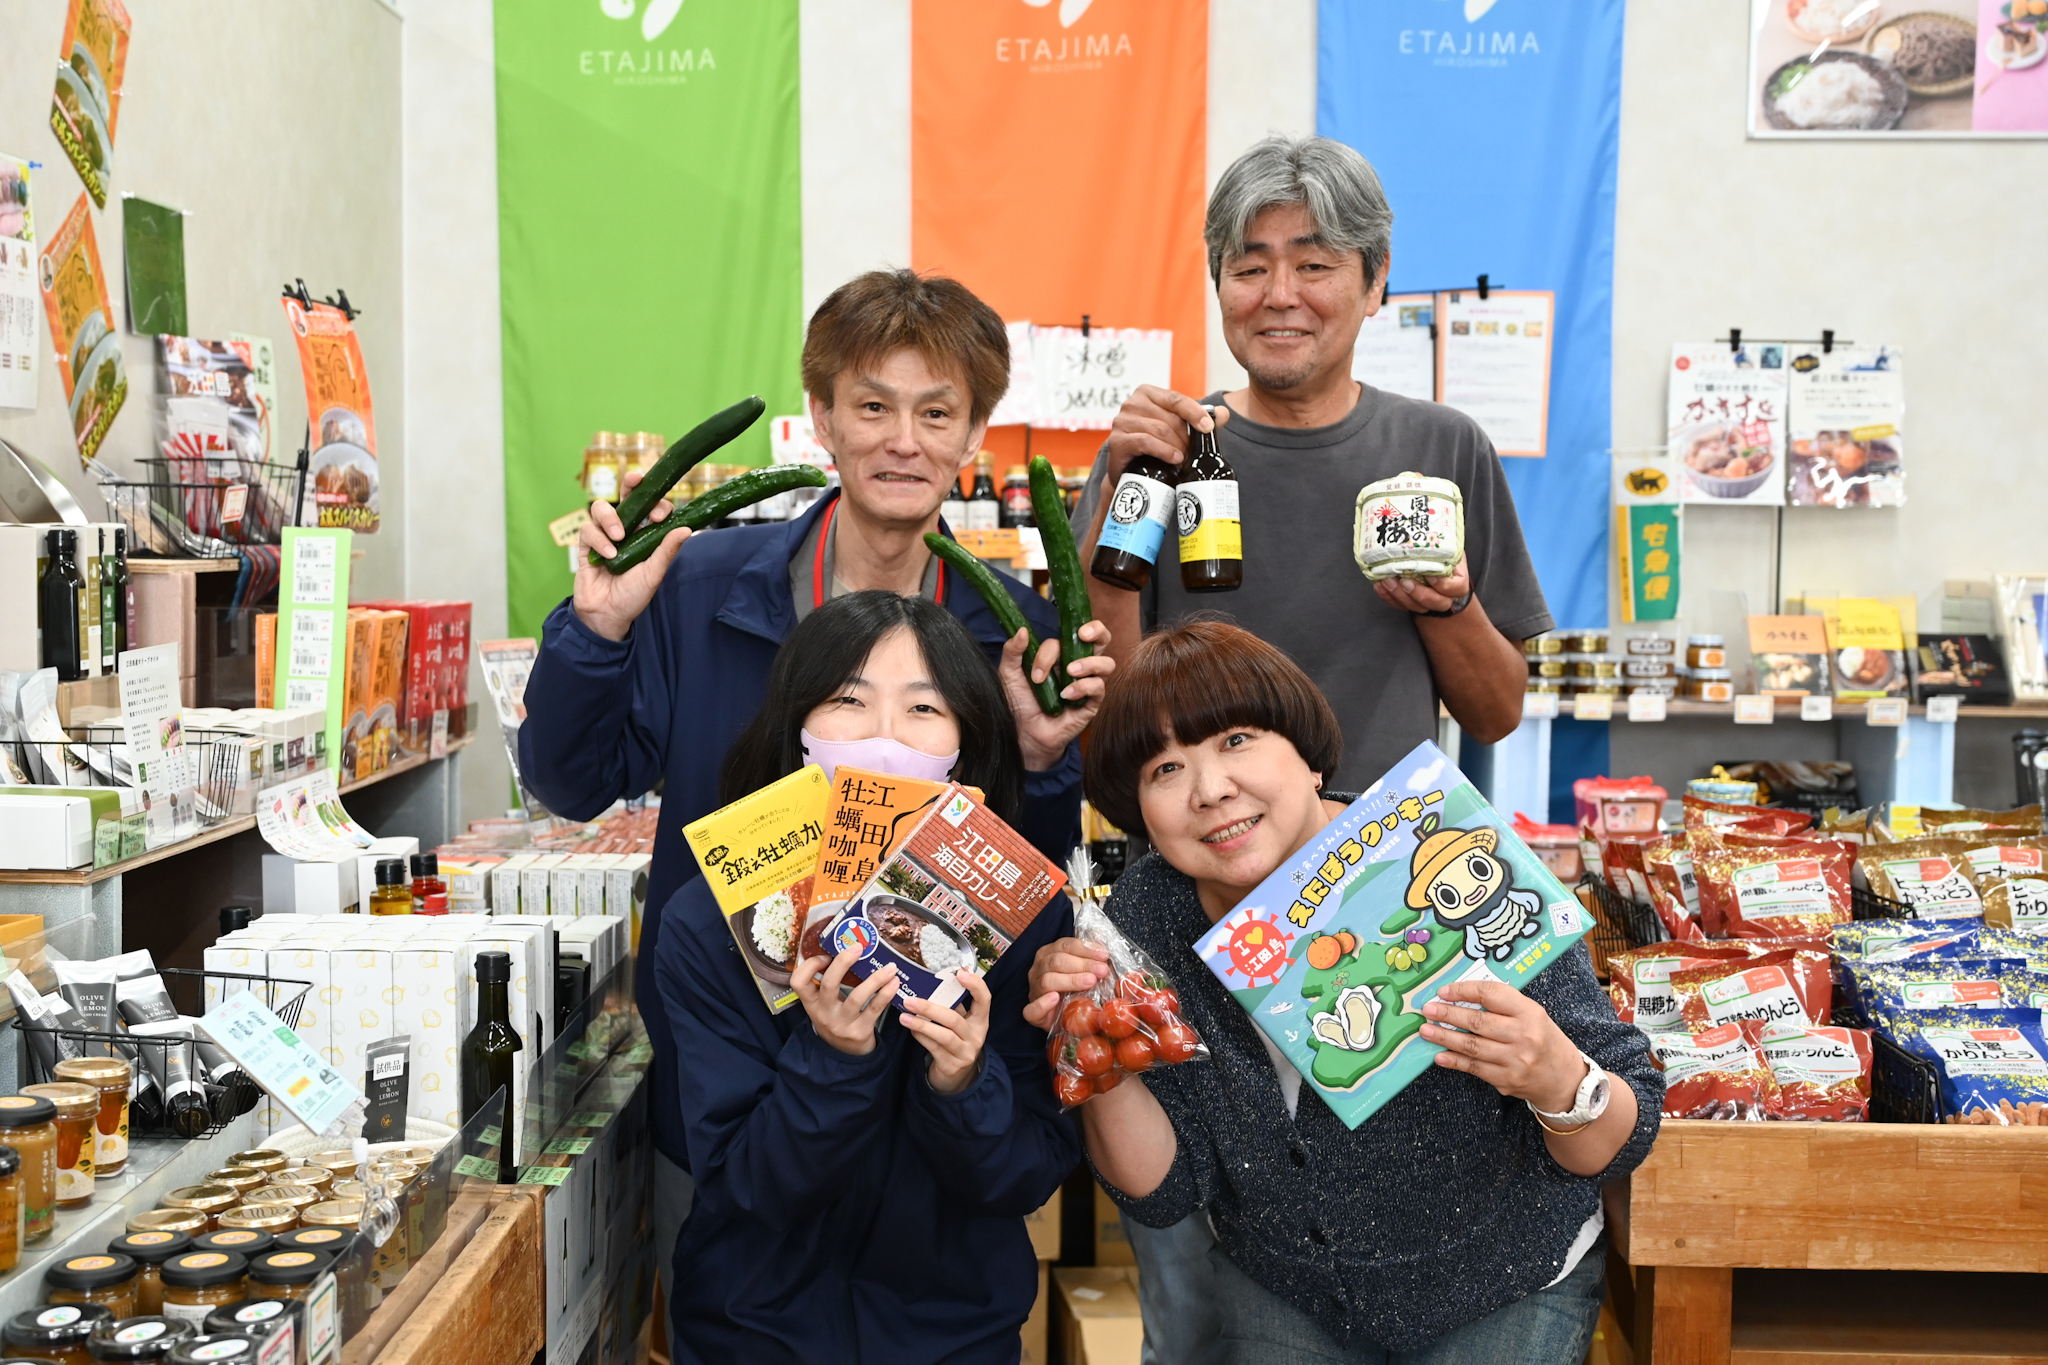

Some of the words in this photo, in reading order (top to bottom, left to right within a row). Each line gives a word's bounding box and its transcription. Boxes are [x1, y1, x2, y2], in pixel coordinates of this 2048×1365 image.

[997, 33, 1133, 63] ETAJIMA
[1399, 28, 1541, 56] ETAJIMA
[579, 47, 717, 76] ETAJIMA
[1029, 59, 1103, 74] HIROSHIMA
[1431, 54, 1509, 68] HIROSHIMA
[613, 74, 688, 87] HIROSHIMA
[1054, 385, 1133, 413] うめぼ
[1406, 494, 1431, 541] 同期の
[1642, 521, 1671, 602] 宅急便
[952, 825, 1023, 890] 江田島
[1286, 789, 1445, 928] えたぼうクッキー
[1333, 864, 1366, 896] ETABOU
[1368, 834, 1402, 864] COOKIE
[930, 841, 1011, 912] 海自カレー
[1234, 939, 1251, 957] I
[1244, 938, 1286, 976] 江田島
[1514, 941, 1552, 975] えたぼう
[78, 1004, 107, 1012] LEMON
[142, 1000, 165, 1010] OLIVE
[145, 1008, 172, 1020] LEMON
[376, 1059, 402, 1075] 試供品
[1943, 1047, 2035, 1060] かりんとう
[379, 1090, 400, 1101] LEMON
[380, 1079, 398, 1088] OLIVE
